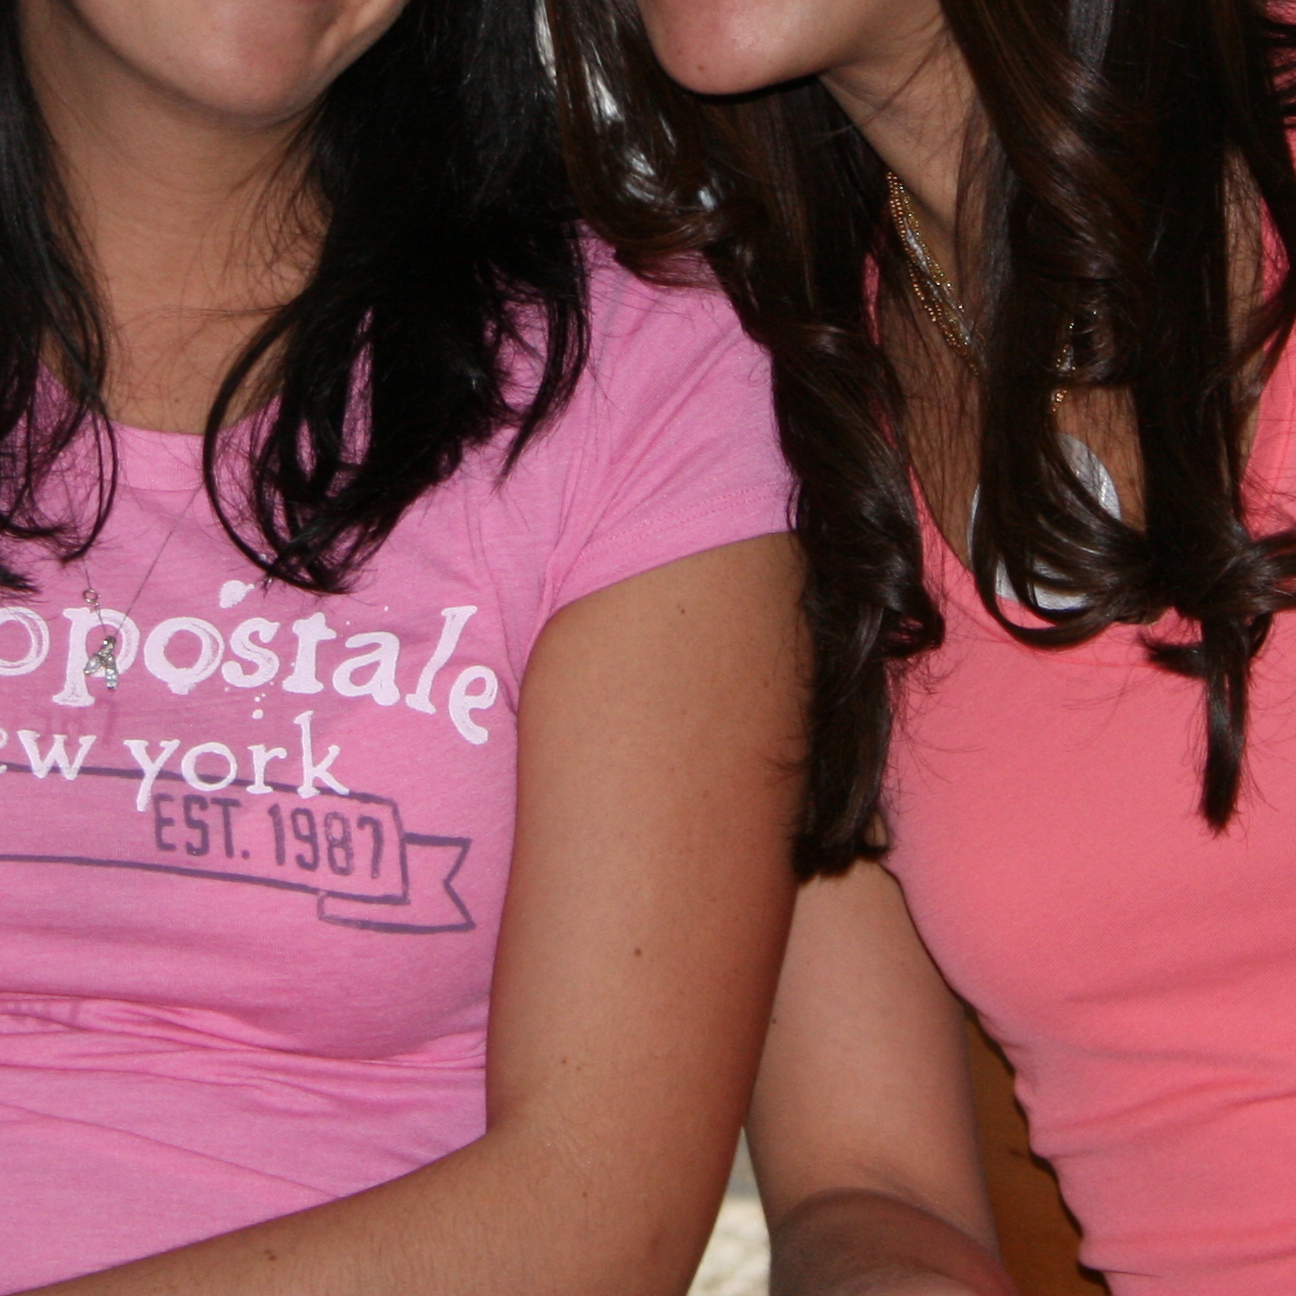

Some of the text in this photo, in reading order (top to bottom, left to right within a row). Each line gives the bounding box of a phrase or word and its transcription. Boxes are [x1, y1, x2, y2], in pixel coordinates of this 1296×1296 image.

[123, 710, 351, 812] york
[154, 792, 385, 880] EST. 1987
